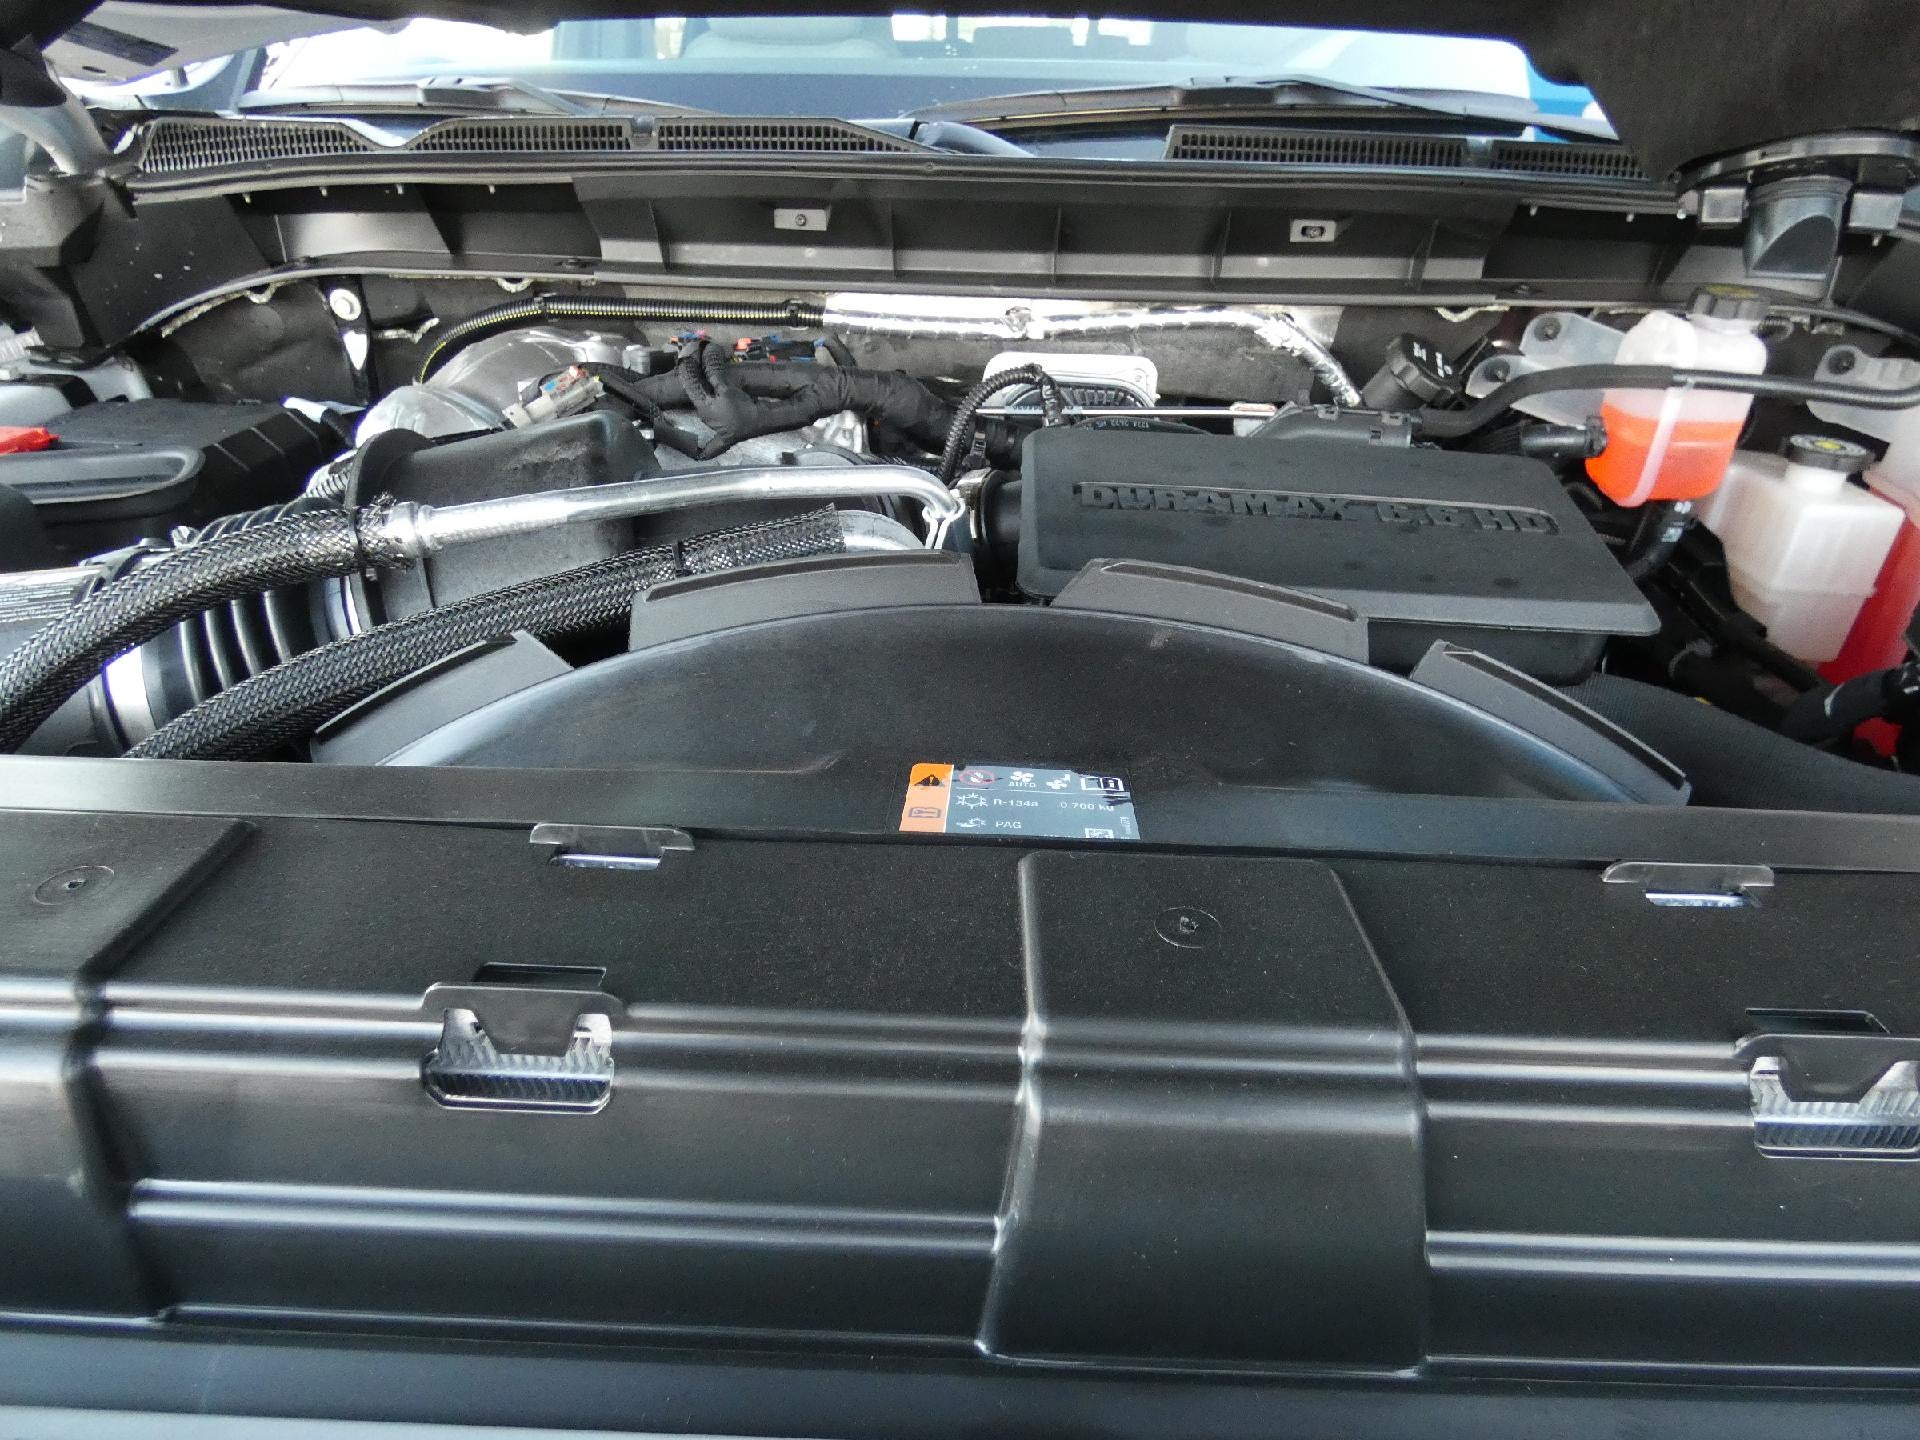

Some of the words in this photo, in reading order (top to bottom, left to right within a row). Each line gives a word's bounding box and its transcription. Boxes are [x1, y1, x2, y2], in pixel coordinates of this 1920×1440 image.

[1072, 484, 1347, 522] DURAMAX
[1474, 507, 1561, 535] HD
[995, 821, 1022, 829] PAG
